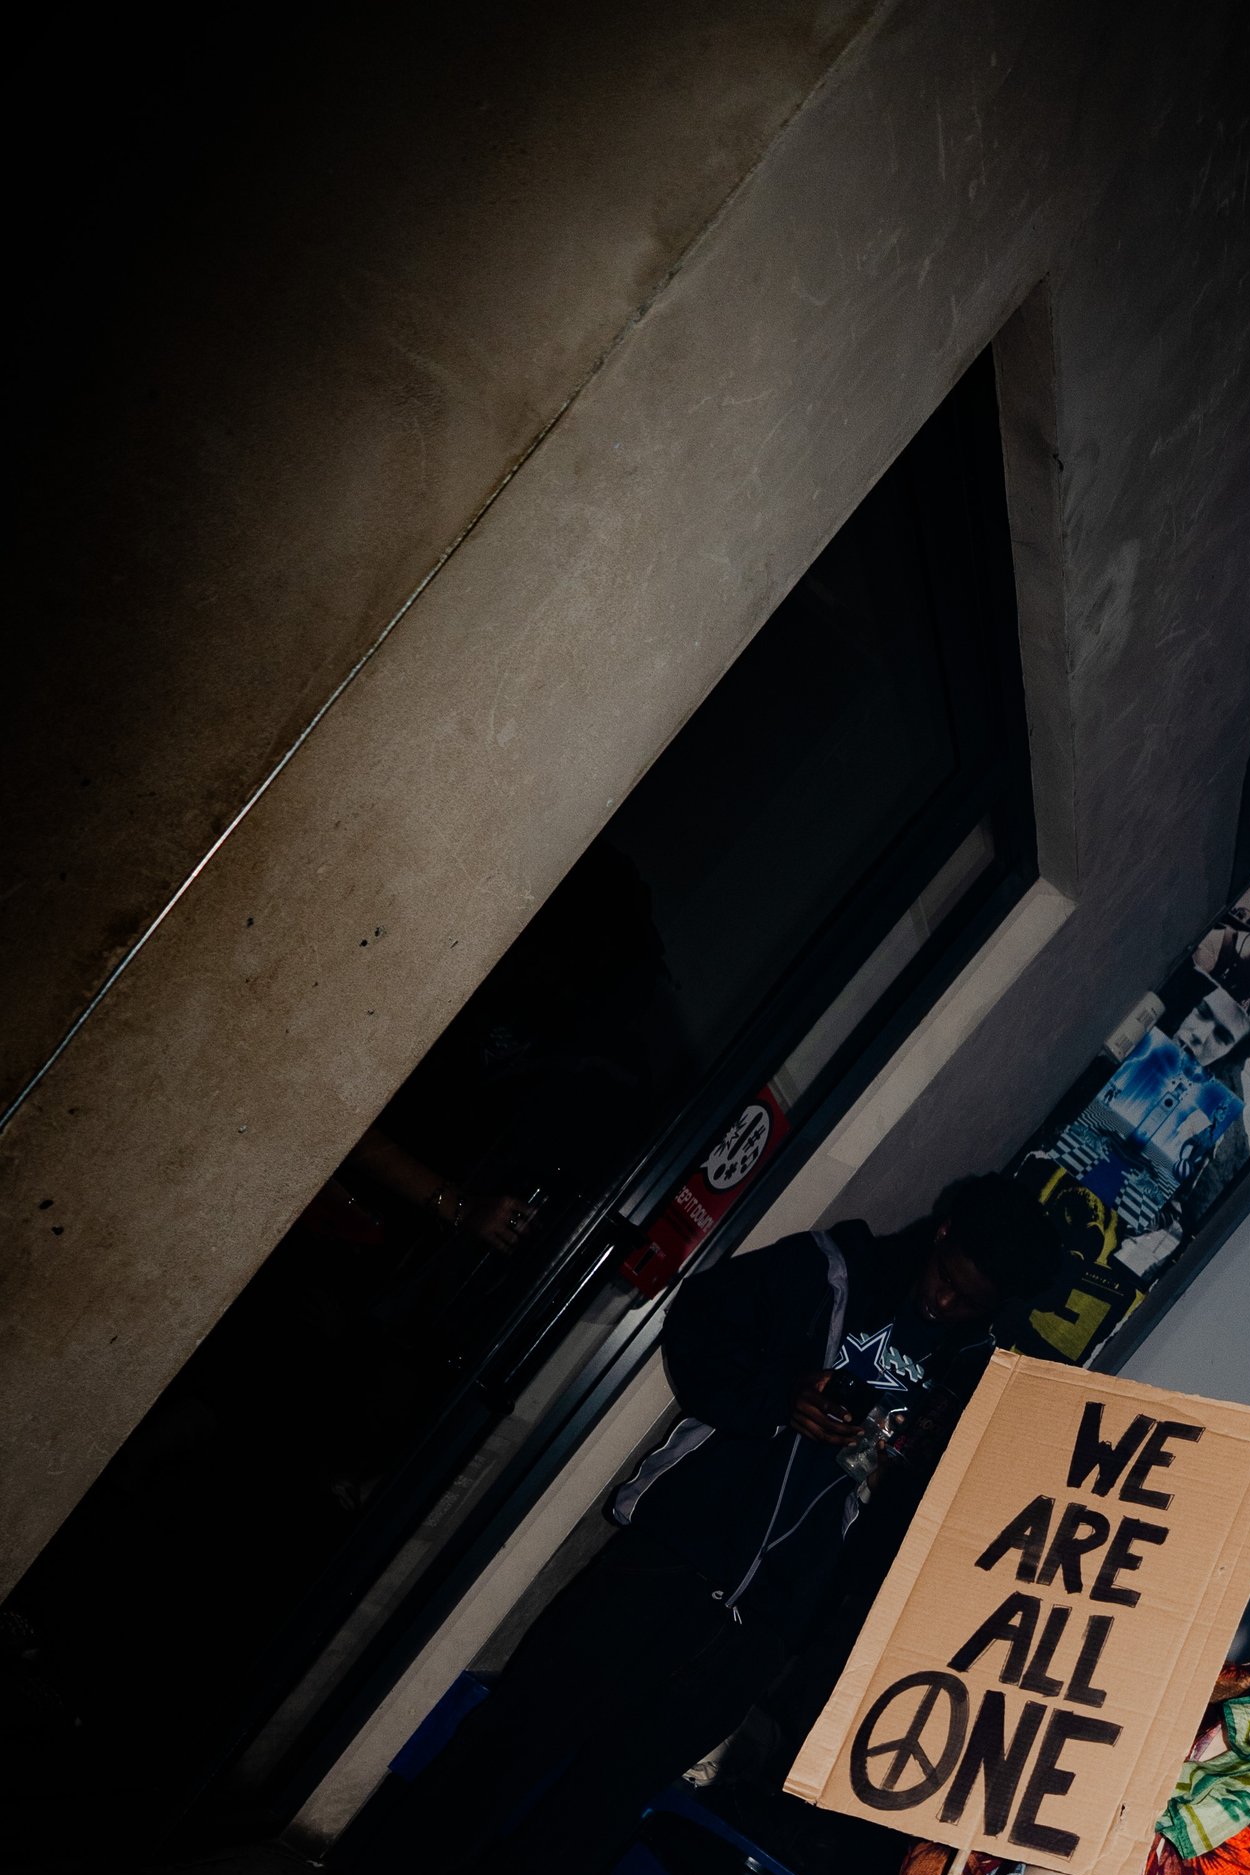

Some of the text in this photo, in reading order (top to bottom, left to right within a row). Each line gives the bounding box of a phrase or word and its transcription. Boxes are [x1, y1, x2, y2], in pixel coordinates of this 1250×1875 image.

[1067, 1402, 1206, 1511] WE
[974, 1494, 1169, 1608] ARE
[947, 1590, 1114, 1709] ALL
[850, 1670, 1124, 1861] ONE
